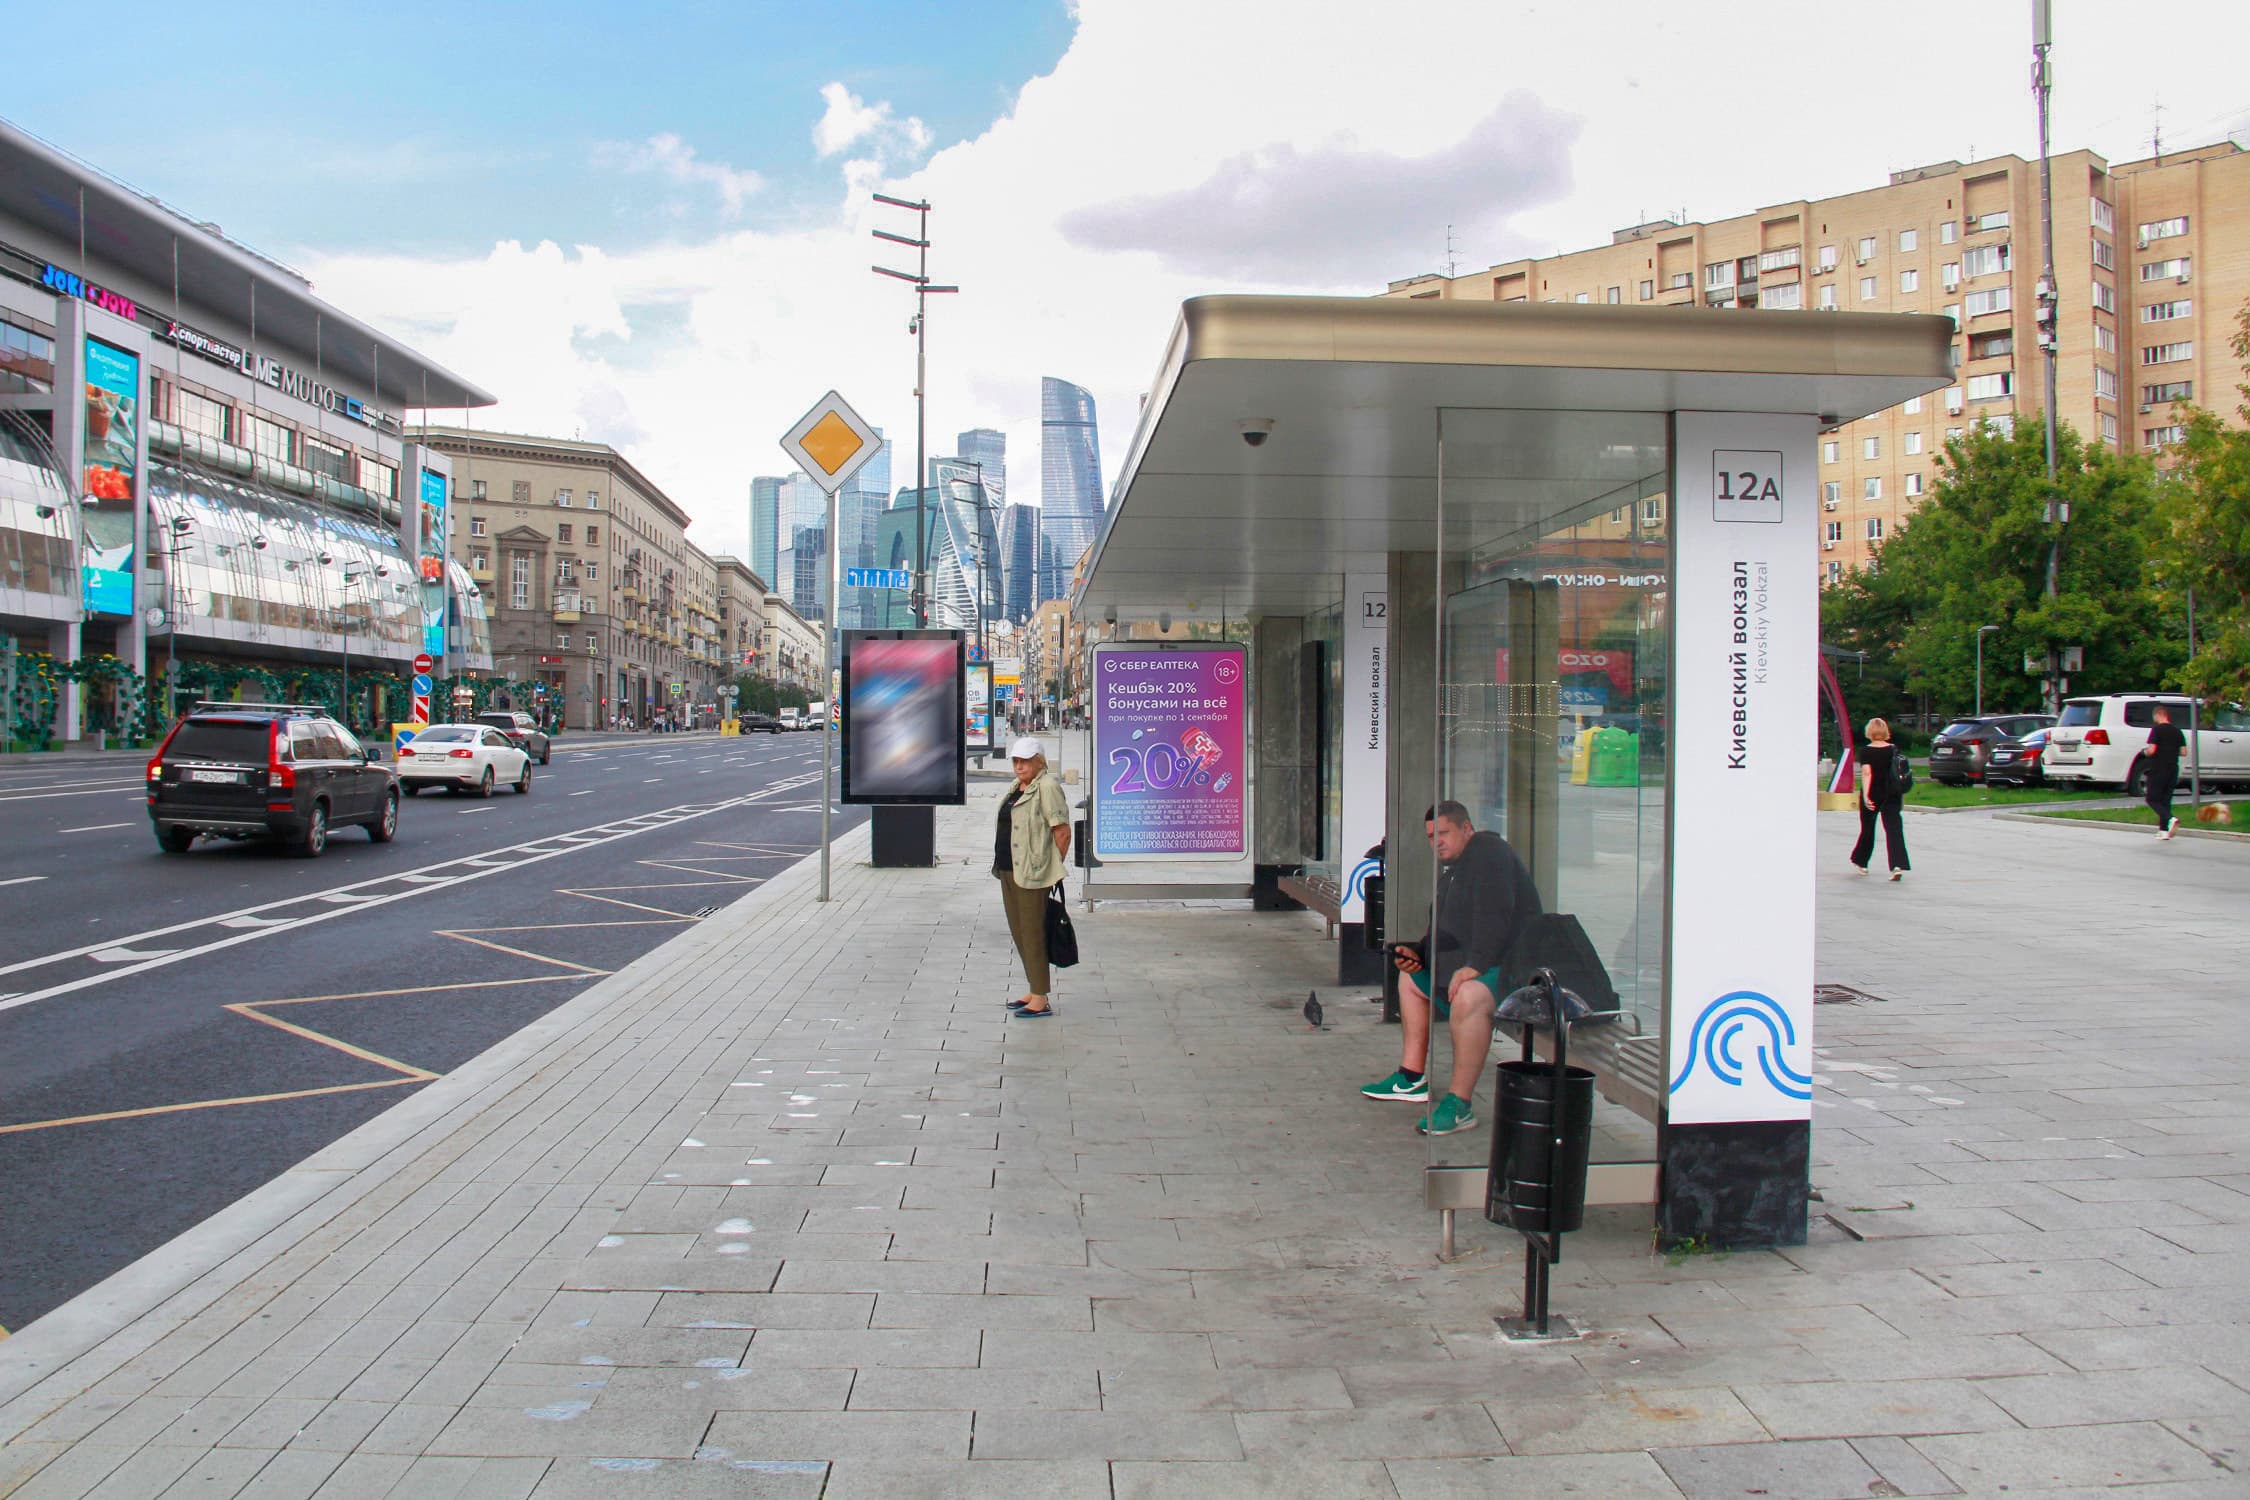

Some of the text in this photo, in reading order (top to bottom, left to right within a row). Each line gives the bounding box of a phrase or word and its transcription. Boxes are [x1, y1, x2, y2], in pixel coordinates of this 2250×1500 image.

[42, 264, 136, 321] JOKI JOYA
[180, 328, 241, 366] спортмастер
[240, 348, 280, 388] LME
[280, 366, 336, 412] MUDO
[1753, 561, 1771, 684] Kievskiy Vokzal
[1119, 661, 1199, 670] СБЕР ЕАПТЕКА
[1219, 667, 1236, 677] 18+
[1727, 561, 1748, 770] Киевский вокзал
[1108, 682, 1197, 694] Кешбэк 20%
[1108, 696, 1228, 712] бонусами на всё
[1368, 647, 1381, 750] Киевский вокзал
[1108, 714, 1125, 723] при
[1127, 714, 1164, 723] покупке
[1180, 713, 1185, 721] 1
[1187, 712, 1229, 723] сентября
[1109, 742, 1210, 795] 20%
